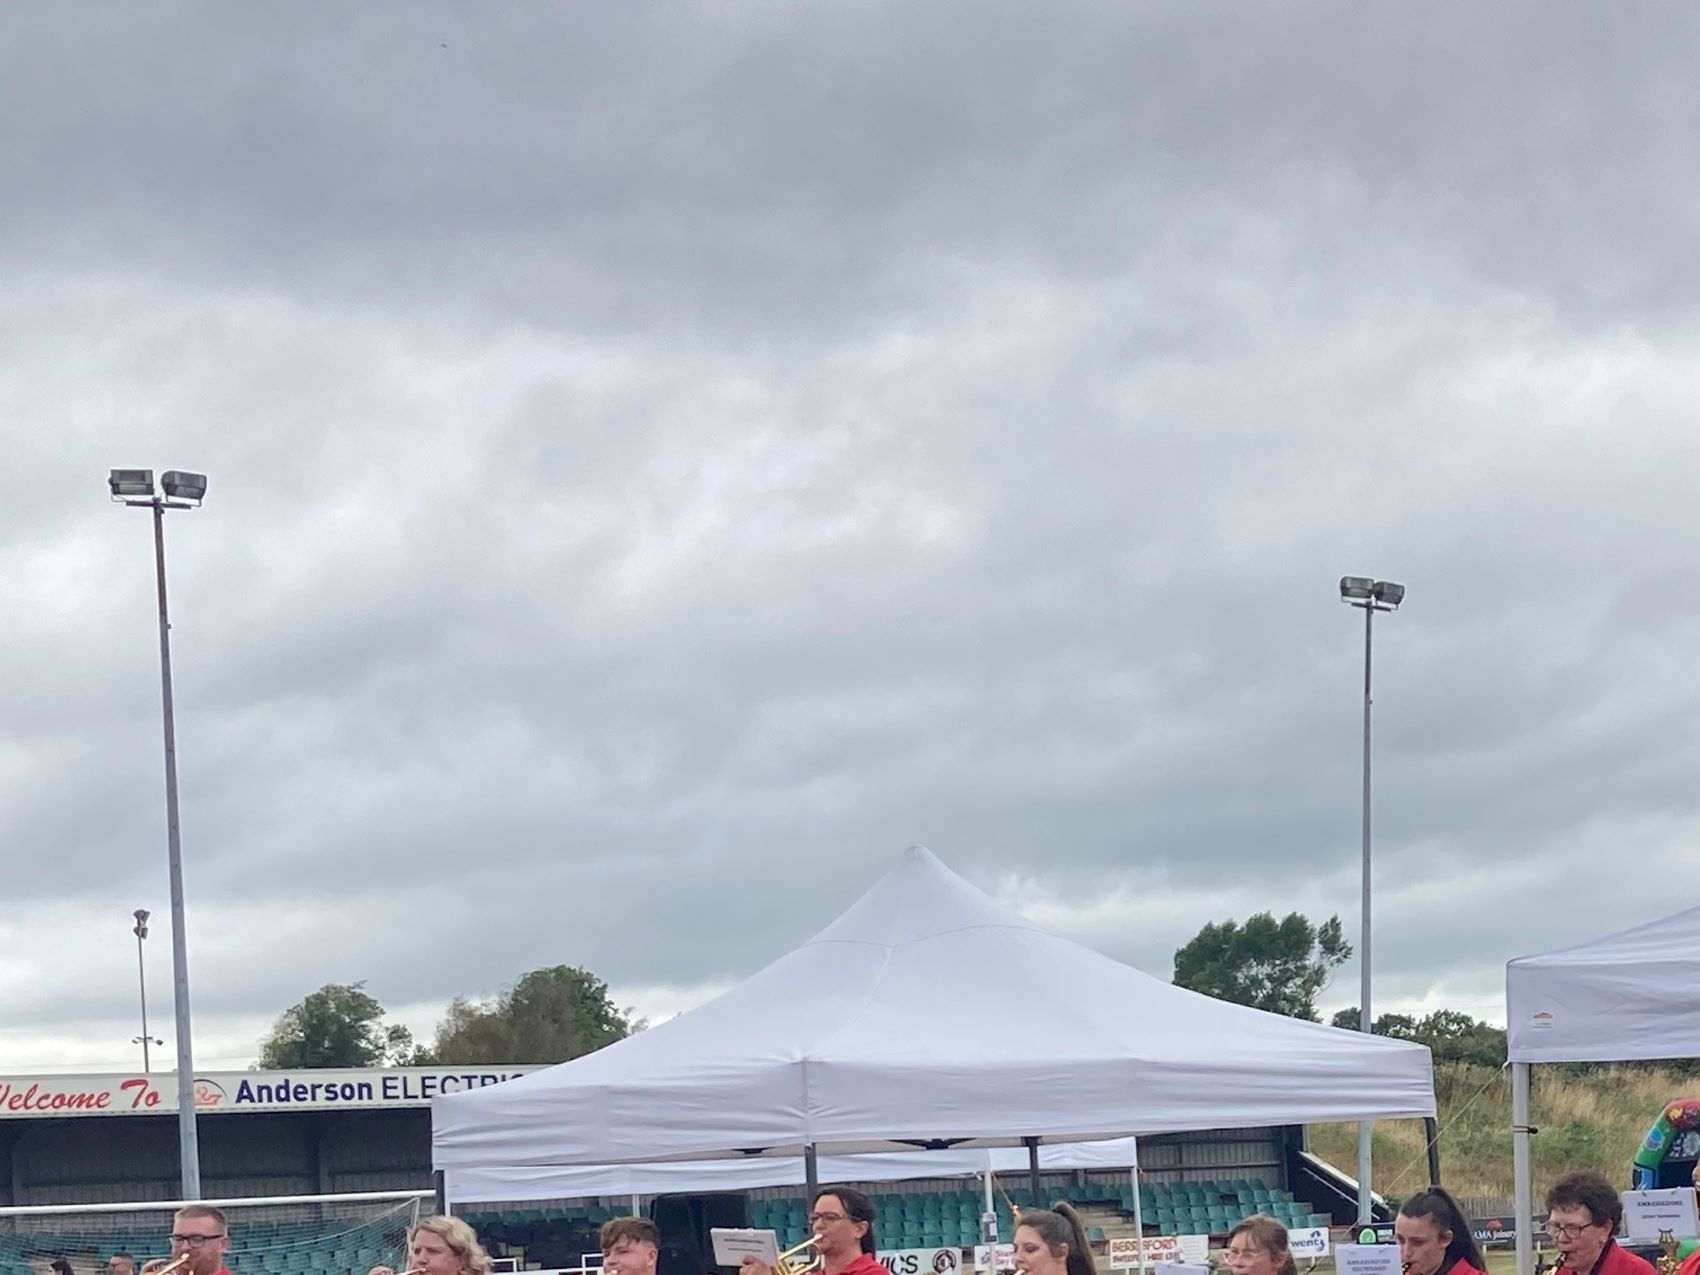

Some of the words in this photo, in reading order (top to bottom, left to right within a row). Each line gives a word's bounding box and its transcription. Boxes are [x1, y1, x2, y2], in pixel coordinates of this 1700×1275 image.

[120, 1079, 161, 1109] To
[235, 1078, 373, 1104] Anderson
[1112, 1239, 1177, 1253] BERRSFORD
